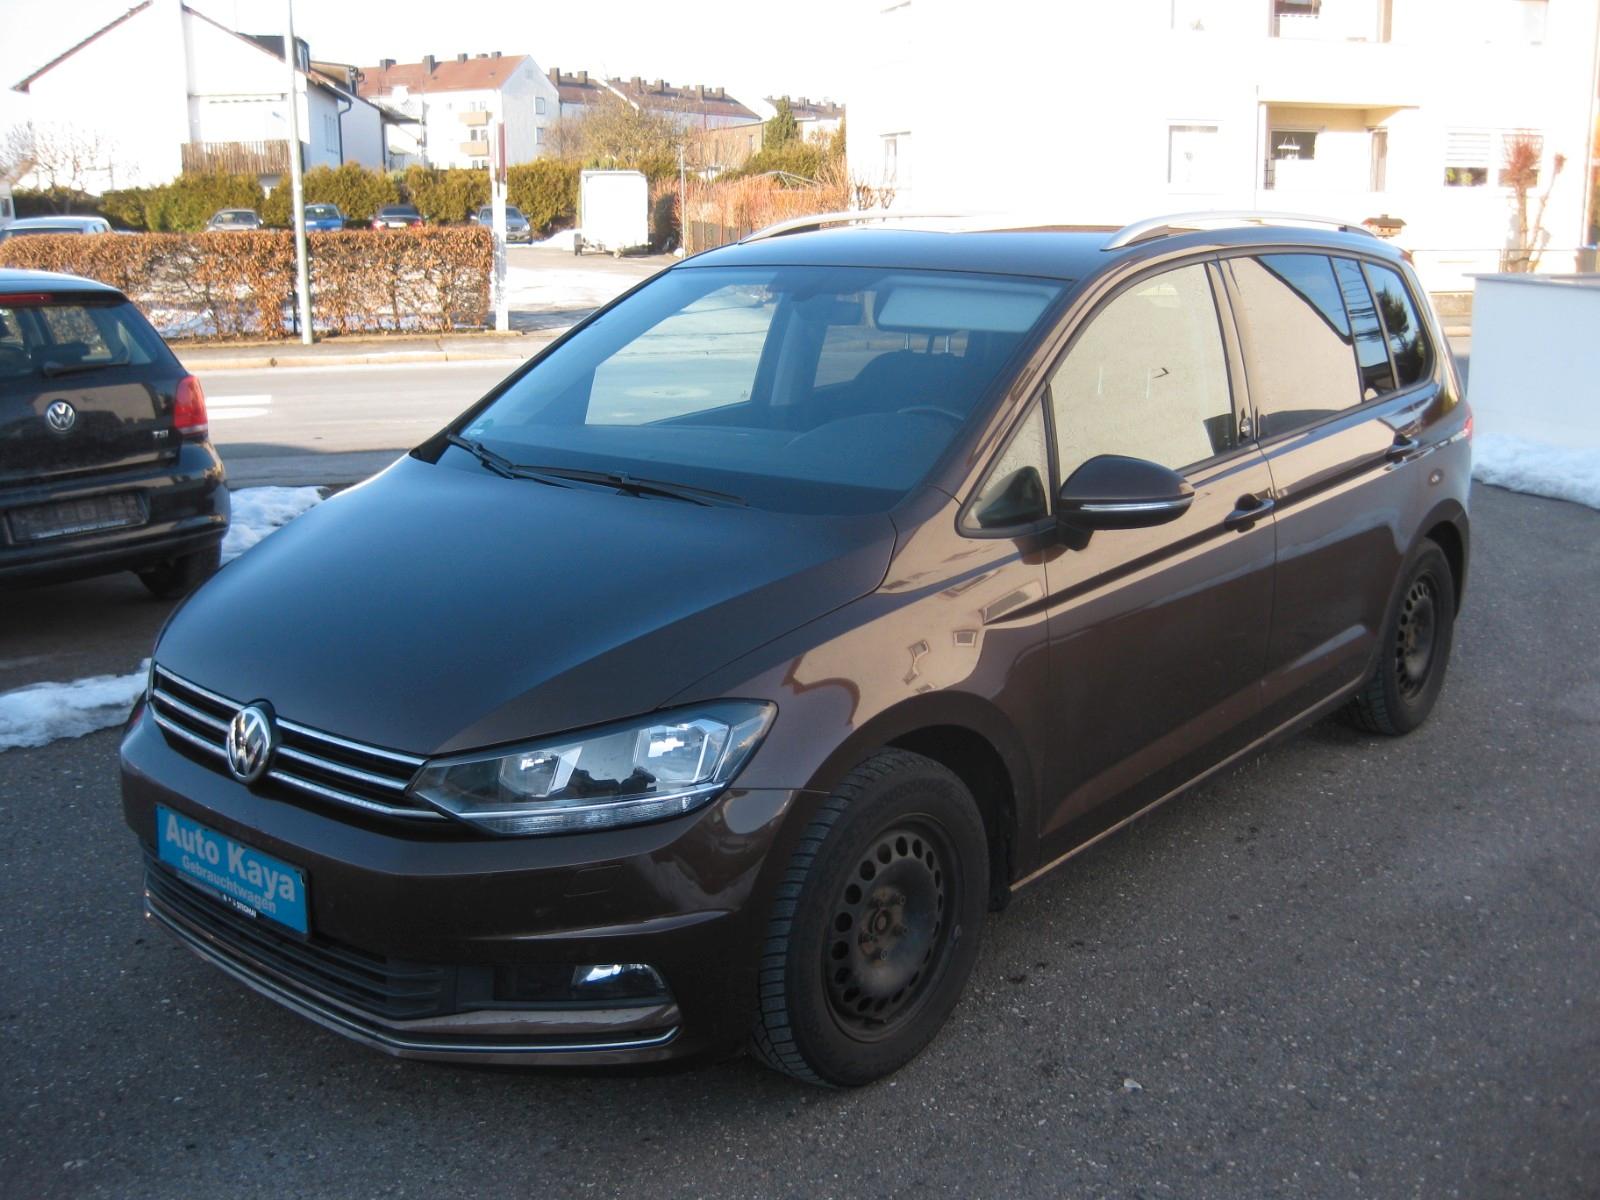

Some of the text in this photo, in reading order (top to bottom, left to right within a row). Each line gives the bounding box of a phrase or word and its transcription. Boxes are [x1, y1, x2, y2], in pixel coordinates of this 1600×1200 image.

[166, 813, 296, 902] Auto Kaya
[182, 855, 277, 914] Gebrauchtwagen
